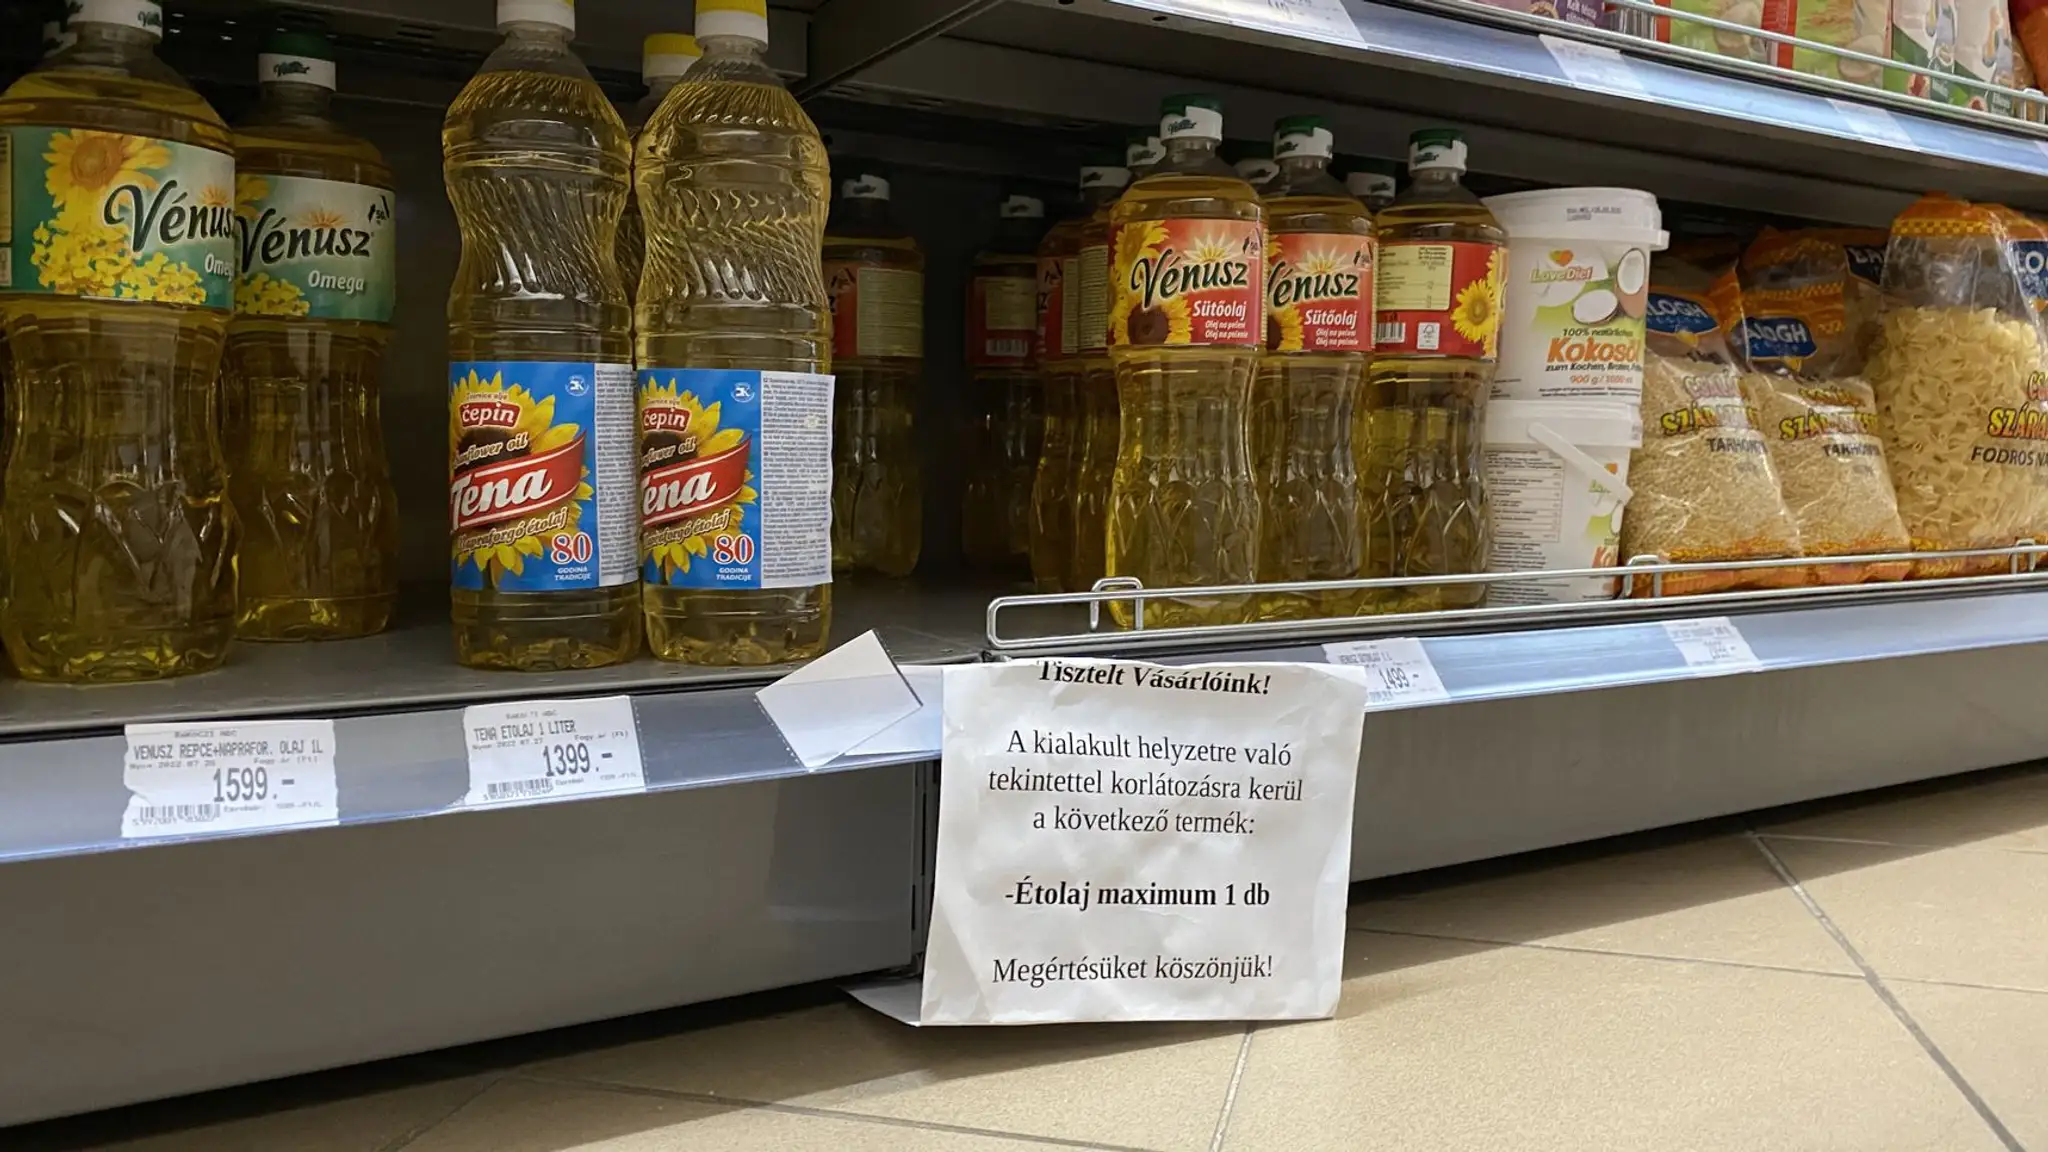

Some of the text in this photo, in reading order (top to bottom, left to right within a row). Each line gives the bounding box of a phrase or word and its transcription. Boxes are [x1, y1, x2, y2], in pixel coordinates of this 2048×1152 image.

[104, 180, 234, 253] Vénus
[235, 208, 370, 273] Vénusz
[204, 253, 234, 283] Omeg
[307, 270, 365, 295] Omega
[1130, 248, 1249, 309] Vénusz
[1192, 300, 1248, 321] Sütőolaj
[1303, 308, 1358, 330] Sütőolaj
[1648, 299, 1709, 319] LOGH
[1562, 327, 1590, 337] 100%
[462, 403, 515, 427] čepin
[506, 431, 529, 452] oil
[677, 435, 696, 454] oil
[1971, 446, 2034, 466] FODROS
[450, 466, 553, 533] Tena
[526, 506, 567, 537] étolaj
[692, 508, 731, 536] étolaj
[551, 531, 593, 565] 80
[713, 533, 755, 565] 80
[557, 566, 588, 574] GODINA
[716, 574, 752, 582] TRADICIJE
[1039, 660, 1271, 696] Tisztelt Vásárlóink!
[473, 727, 497, 742] TENA
[548, 719, 576, 735] LITER
[134, 743, 173, 760] VENUSZ
[280, 739, 304, 755] OLAJ
[1007, 729, 1292, 767] A kialakult helyzetre való
[988, 766, 1303, 802] tekintettel korlátozásra kerül
[1033, 804, 1255, 835] a következő termék:
[1005, 875, 1270, 912] -Étolaj maximum 1 db
[992, 954, 1273, 989] Megértésüket köszönjük!
